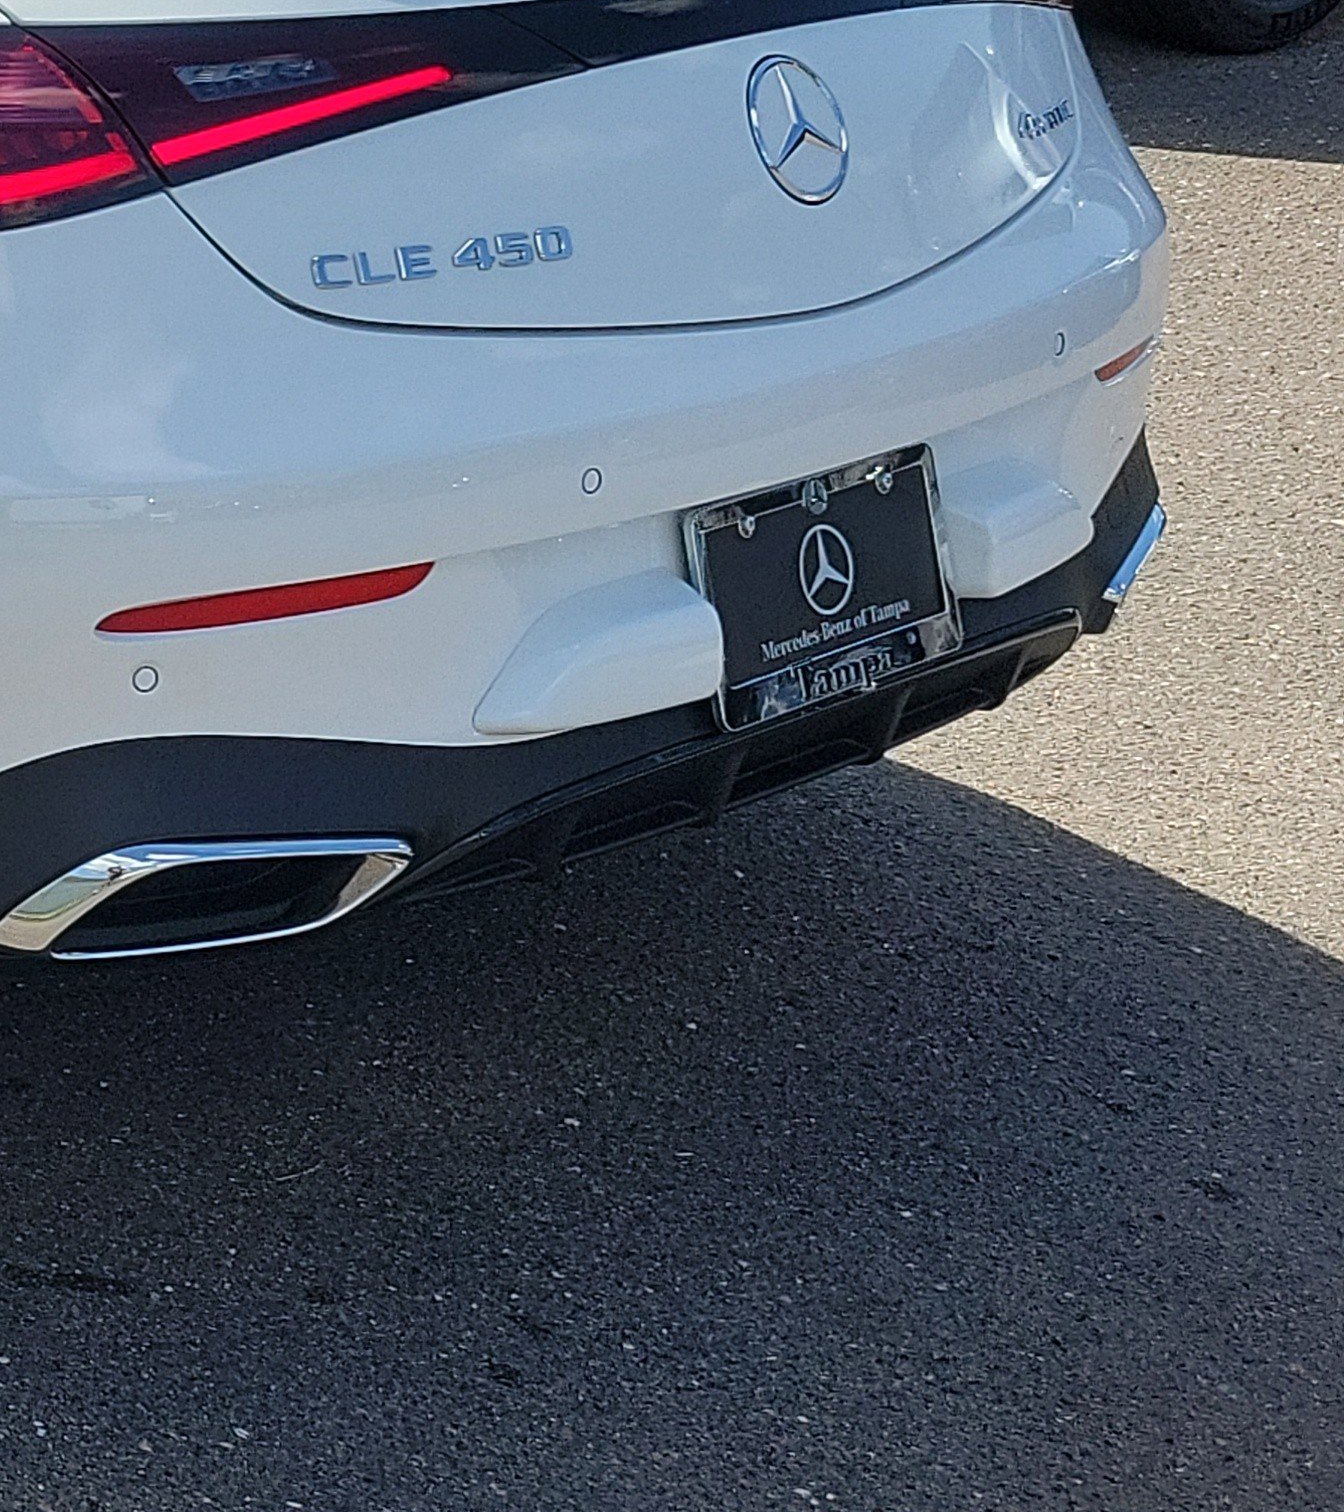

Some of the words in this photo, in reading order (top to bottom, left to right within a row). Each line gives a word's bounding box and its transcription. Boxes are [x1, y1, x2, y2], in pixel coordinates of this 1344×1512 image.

[311, 244, 438, 289] CLE
[452, 225, 574, 271] 450
[761, 618, 852, 662] Mercedes-Benz
[853, 609, 867, 629] of
[869, 599, 910, 620] Tampa
[790, 651, 893, 702] Tampa
